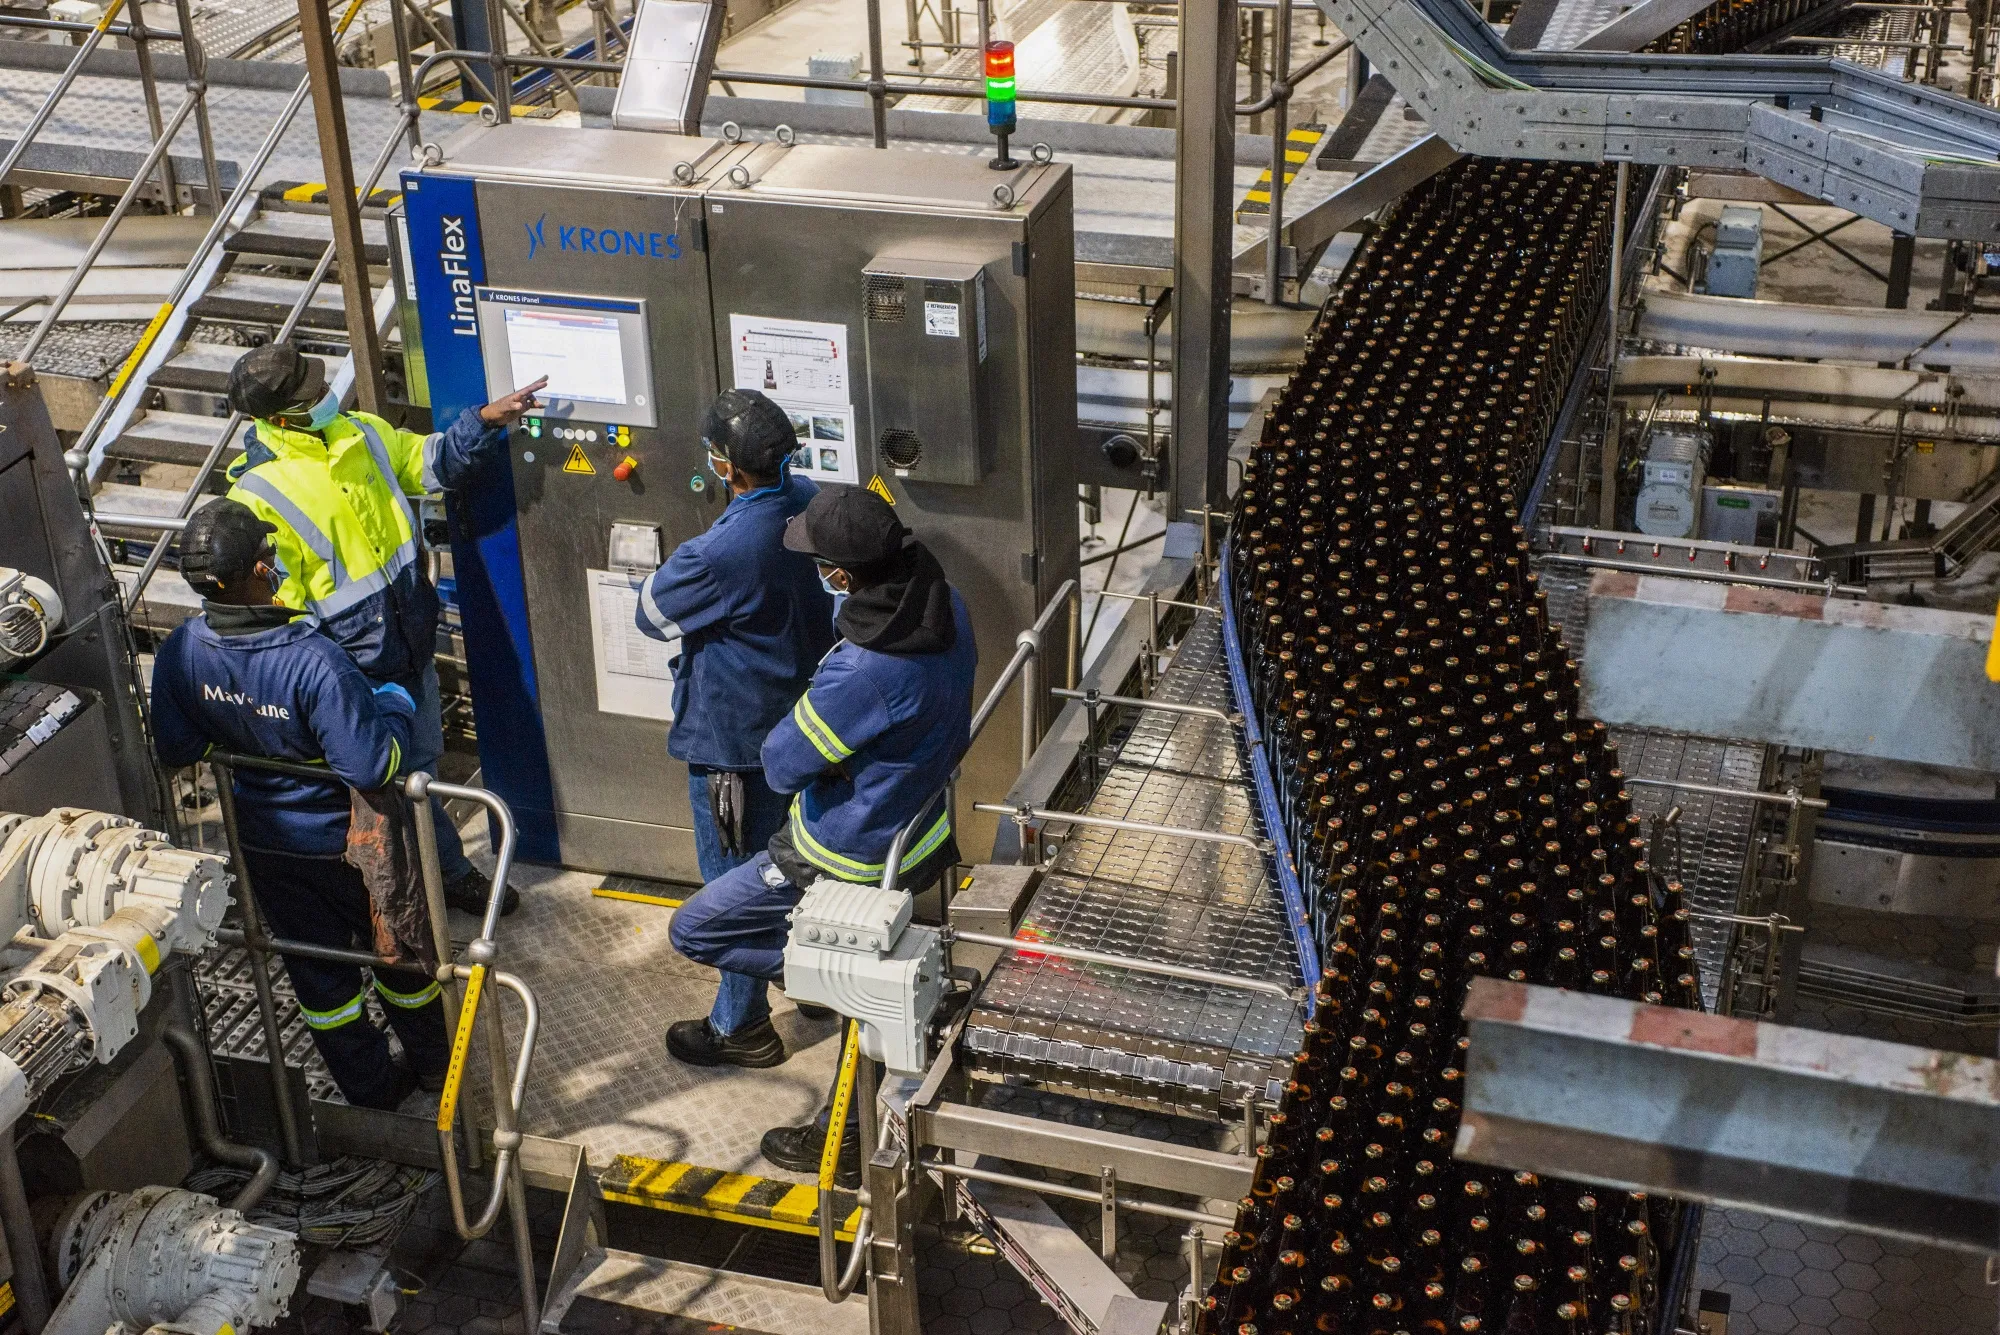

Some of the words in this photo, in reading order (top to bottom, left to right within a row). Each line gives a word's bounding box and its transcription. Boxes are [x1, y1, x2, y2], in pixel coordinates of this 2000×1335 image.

[559, 225, 682, 260] KRONES
[441, 217, 478, 336] LinaFlex
[495, 294, 521, 303] KRONES
[521, 295, 540, 304] iPanel
[465, 988, 475, 1014] USE
[444, 1026, 467, 1109] HANDRAILS
[846, 1043, 856, 1069] USE
[825, 1081, 848, 1167] HANDRAILS
